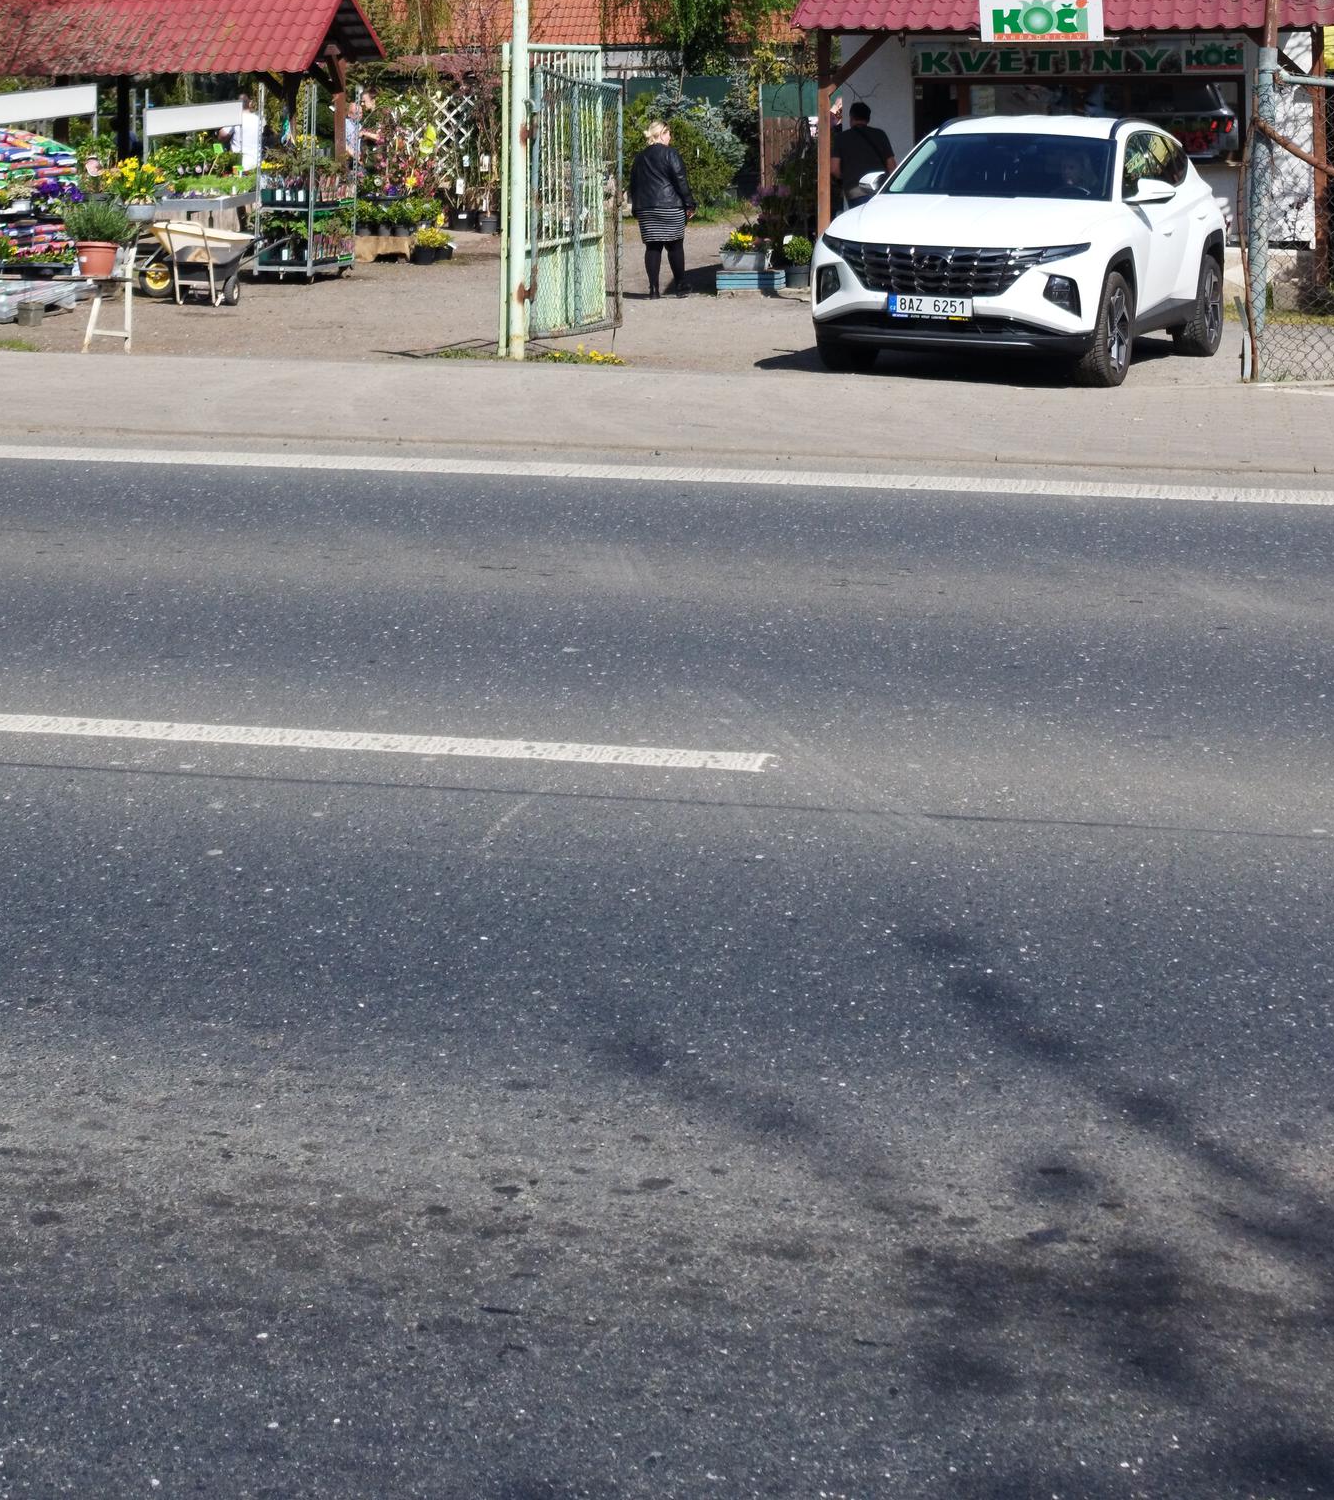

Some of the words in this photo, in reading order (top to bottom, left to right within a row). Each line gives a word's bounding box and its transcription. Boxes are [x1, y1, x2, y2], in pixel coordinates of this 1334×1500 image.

[920, 46, 1171, 74] KVĚTINY
[899, 297, 923, 312] 8AZ
[933, 299, 965, 314] 6251
